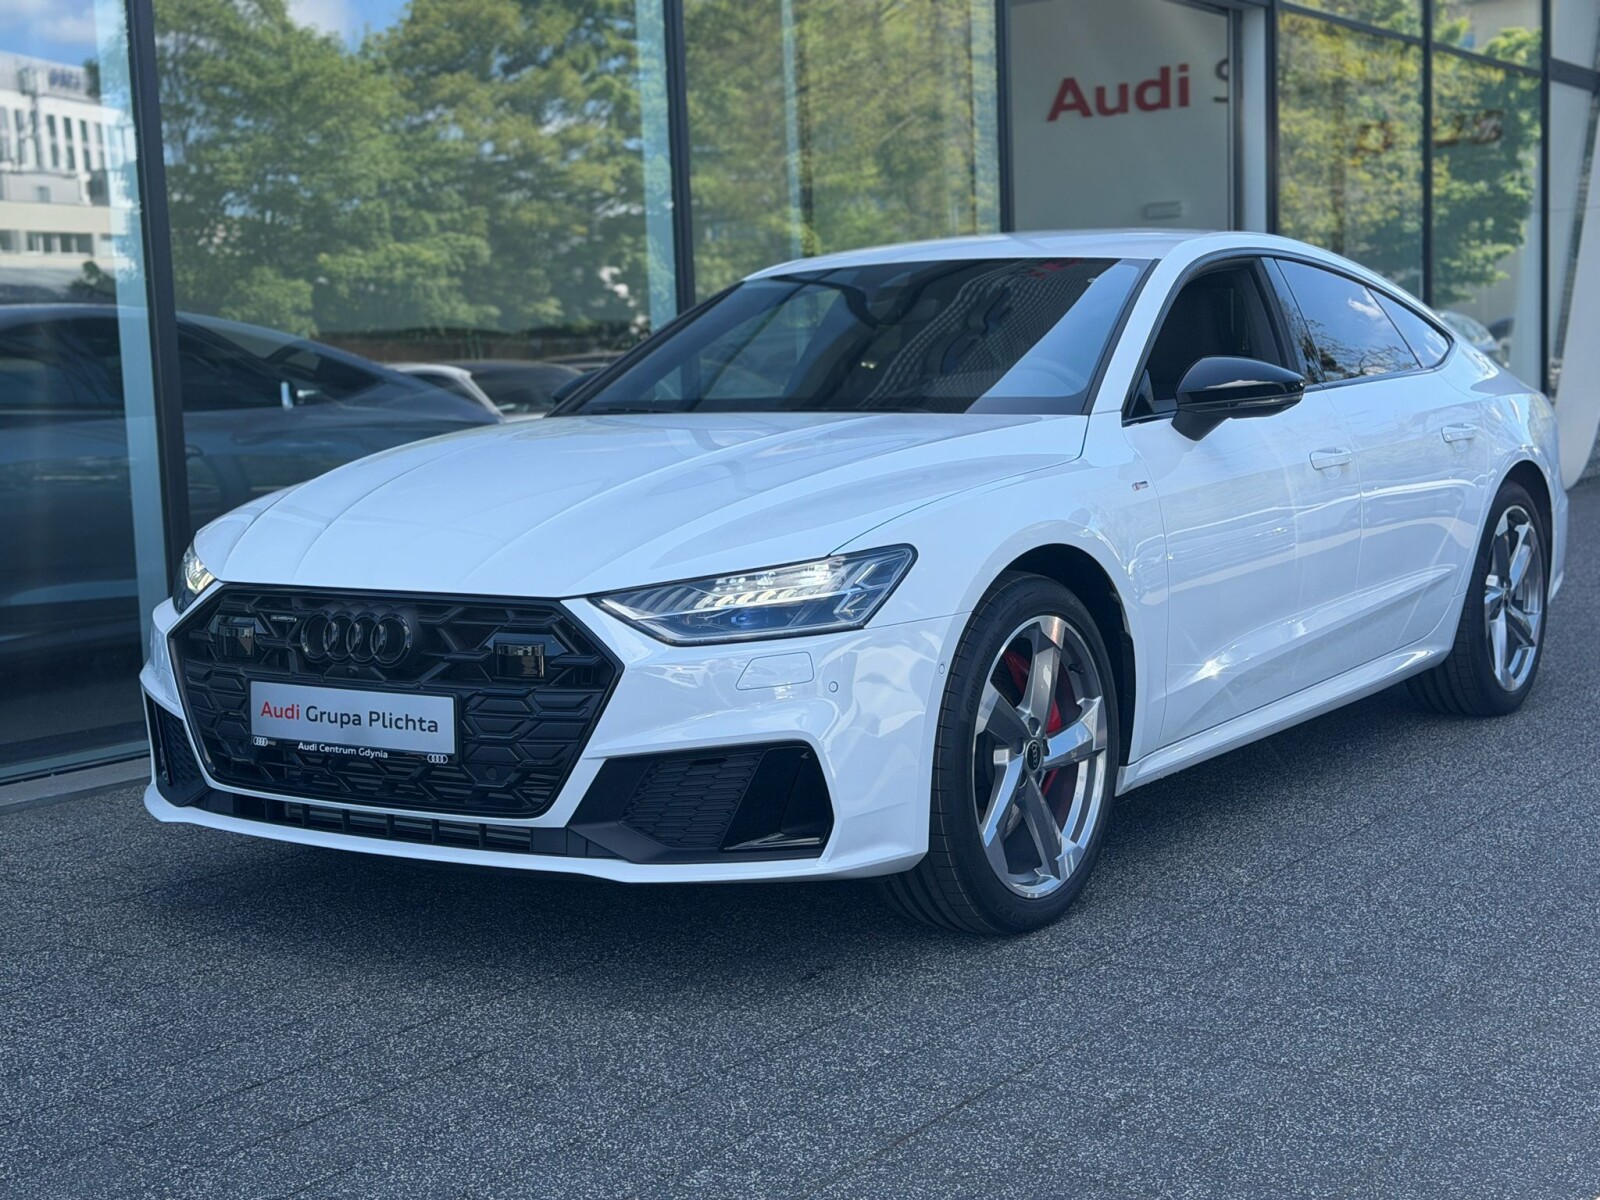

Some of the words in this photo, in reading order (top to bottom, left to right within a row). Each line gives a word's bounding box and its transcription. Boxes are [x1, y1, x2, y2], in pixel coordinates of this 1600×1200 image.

[1046, 63, 1190, 122] Audi
[260, 701, 300, 720] Audi
[305, 705, 362, 729] Grupa
[368, 710, 439, 733] Plichta
[298, 742, 318, 752] Audi
[319, 744, 357, 755] Centrum
[358, 747, 389, 759] Gdynia
